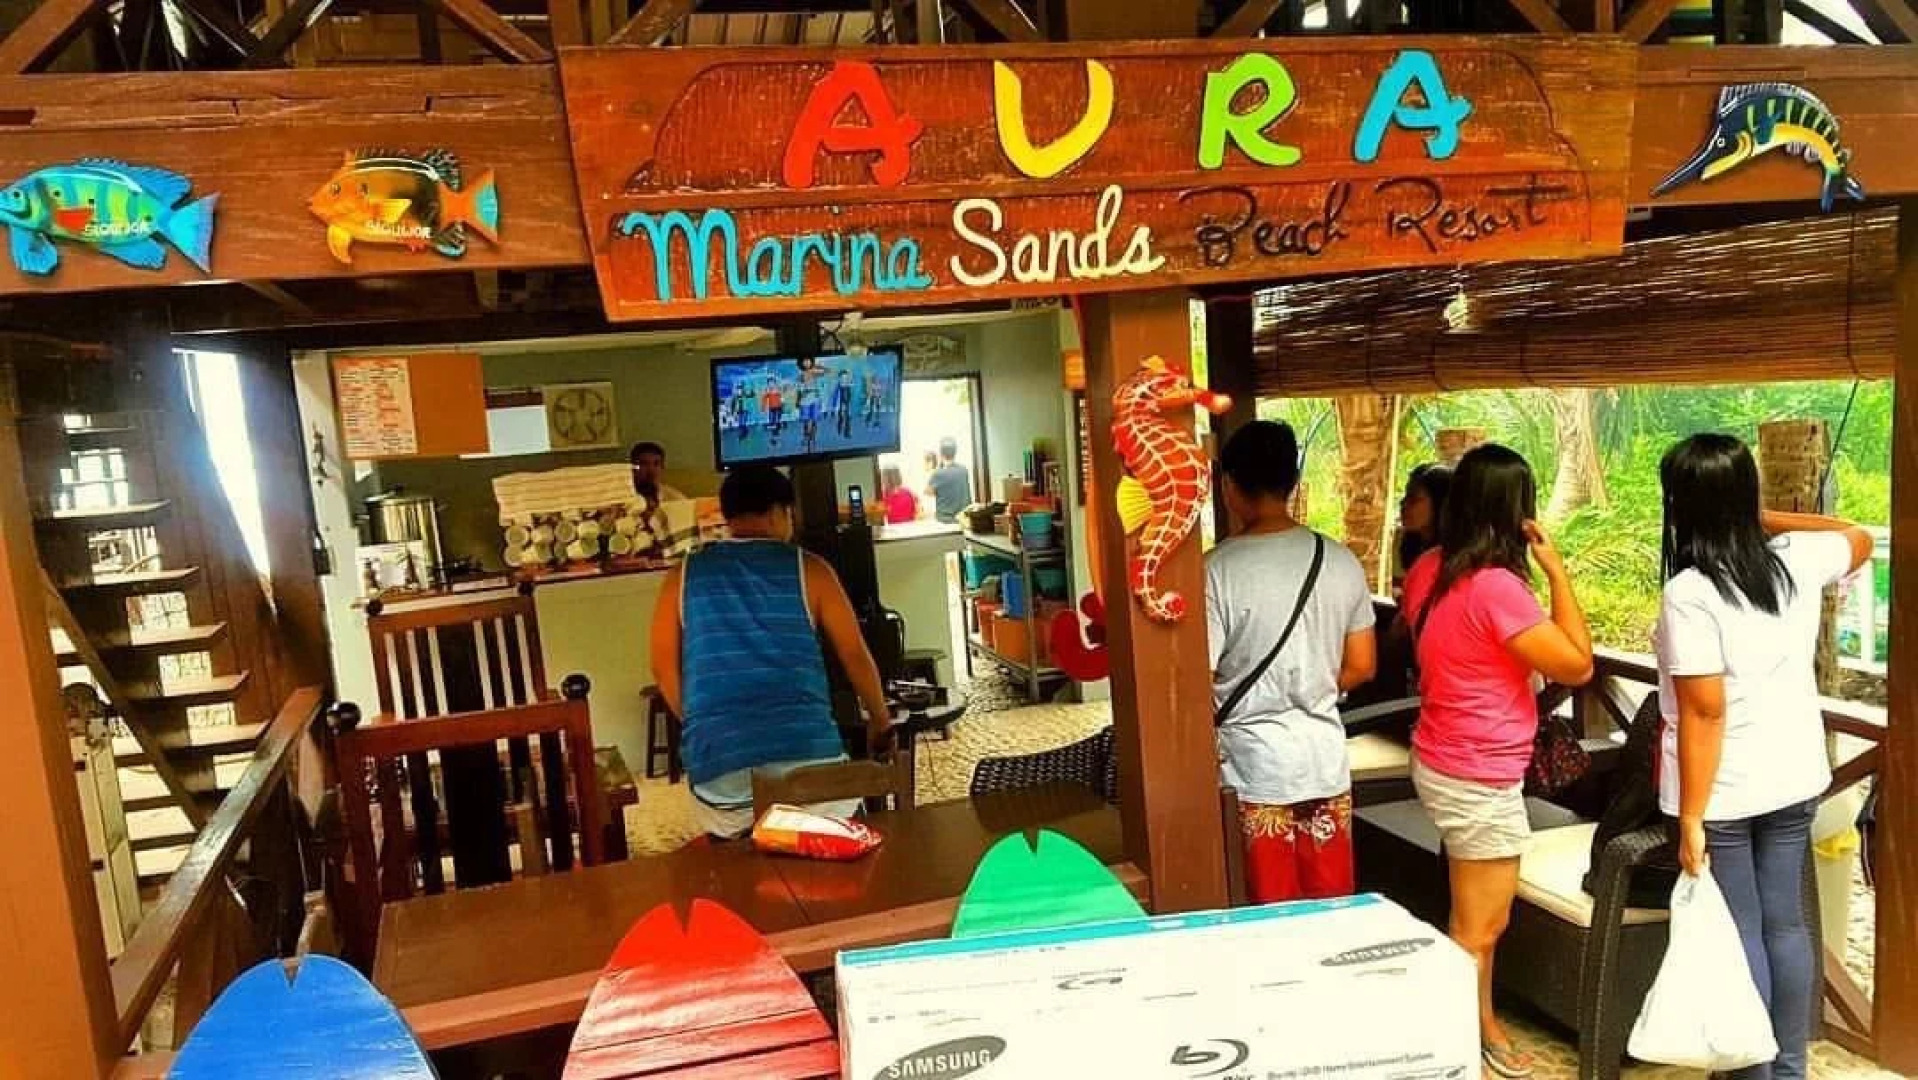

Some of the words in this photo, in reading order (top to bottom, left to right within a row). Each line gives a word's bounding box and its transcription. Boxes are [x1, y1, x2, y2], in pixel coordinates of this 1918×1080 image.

[783, 48, 1471, 188] AURA
[623, 207, 934, 301] Marina
[951, 184, 1166, 286] Sands
[1179, 181, 1351, 268] Beach
[1375, 174, 1571, 254] Resort
[887, 1049, 991, 1079] SAMSUNG
